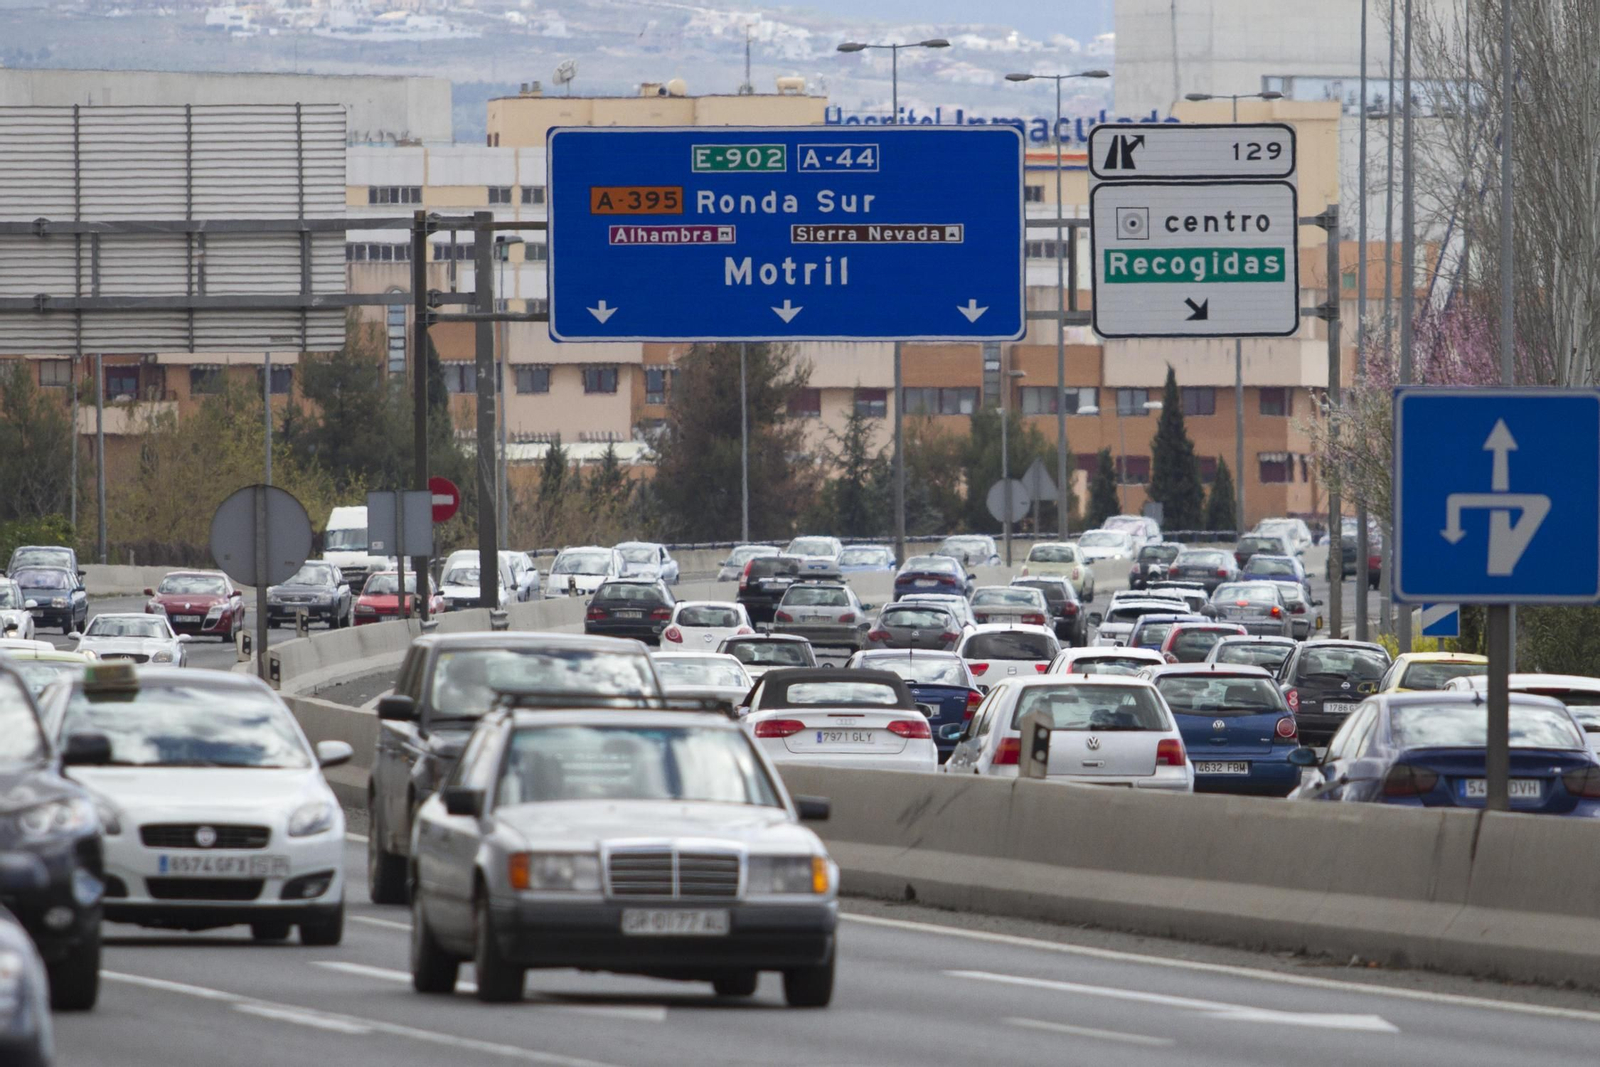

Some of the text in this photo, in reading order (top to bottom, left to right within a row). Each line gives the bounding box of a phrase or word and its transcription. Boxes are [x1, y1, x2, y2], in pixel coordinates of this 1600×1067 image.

[696, 148, 782, 168] E-902
[802, 148, 875, 168] A-44
[1232, 142, 1282, 161] 129
[596, 190, 678, 210] A-395
[697, 189, 876, 214] Ronda Sur
[1164, 210, 1270, 233] centro
[614, 227, 712, 243] Alhambra
[796, 225, 940, 242] Sierra Nevada
[724, 256, 848, 286] Motril
[1109, 251, 1281, 282] Recogidas
[823, 732, 872, 742] 7971 GLY
[1198, 762, 1223, 773] 4632
